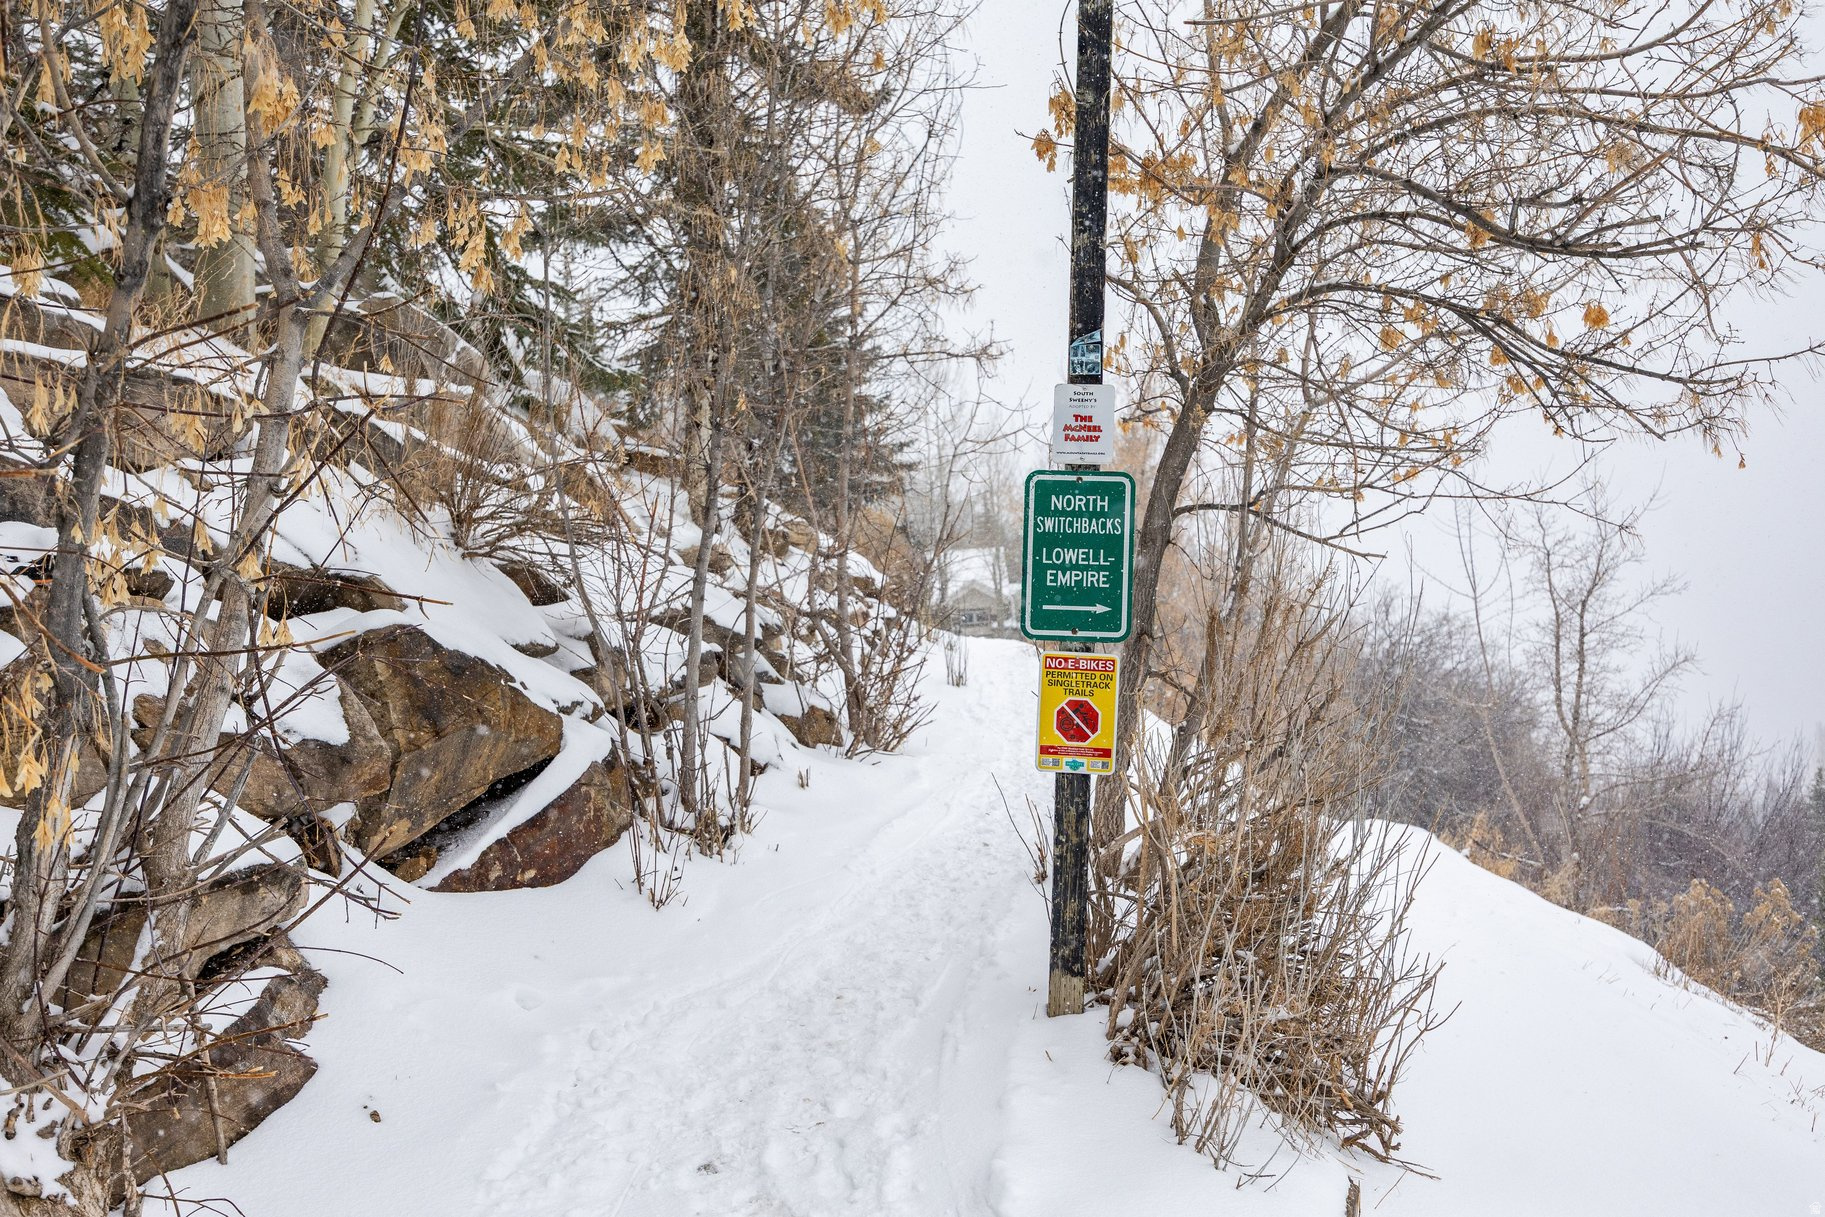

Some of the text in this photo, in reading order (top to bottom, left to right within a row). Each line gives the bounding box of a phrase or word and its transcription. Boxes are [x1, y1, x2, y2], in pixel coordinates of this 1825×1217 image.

[1073, 414, 1092, 422] THE
[1064, 434, 1100, 442] FAMILY
[1051, 495, 1108, 511] NORTH
[1036, 516, 1122, 534] SWITCHBACKS
[1042, 548, 1115, 565] LOWELL-
[1046, 570, 1110, 588] EMPIRE
[1046, 658, 1114, 671] NO E-BIKES
[1046, 670, 1114, 682] PERMITTED ON
[1047, 679, 1110, 690] SINGLETRACK
[1063, 688, 1094, 696] TRAILS
